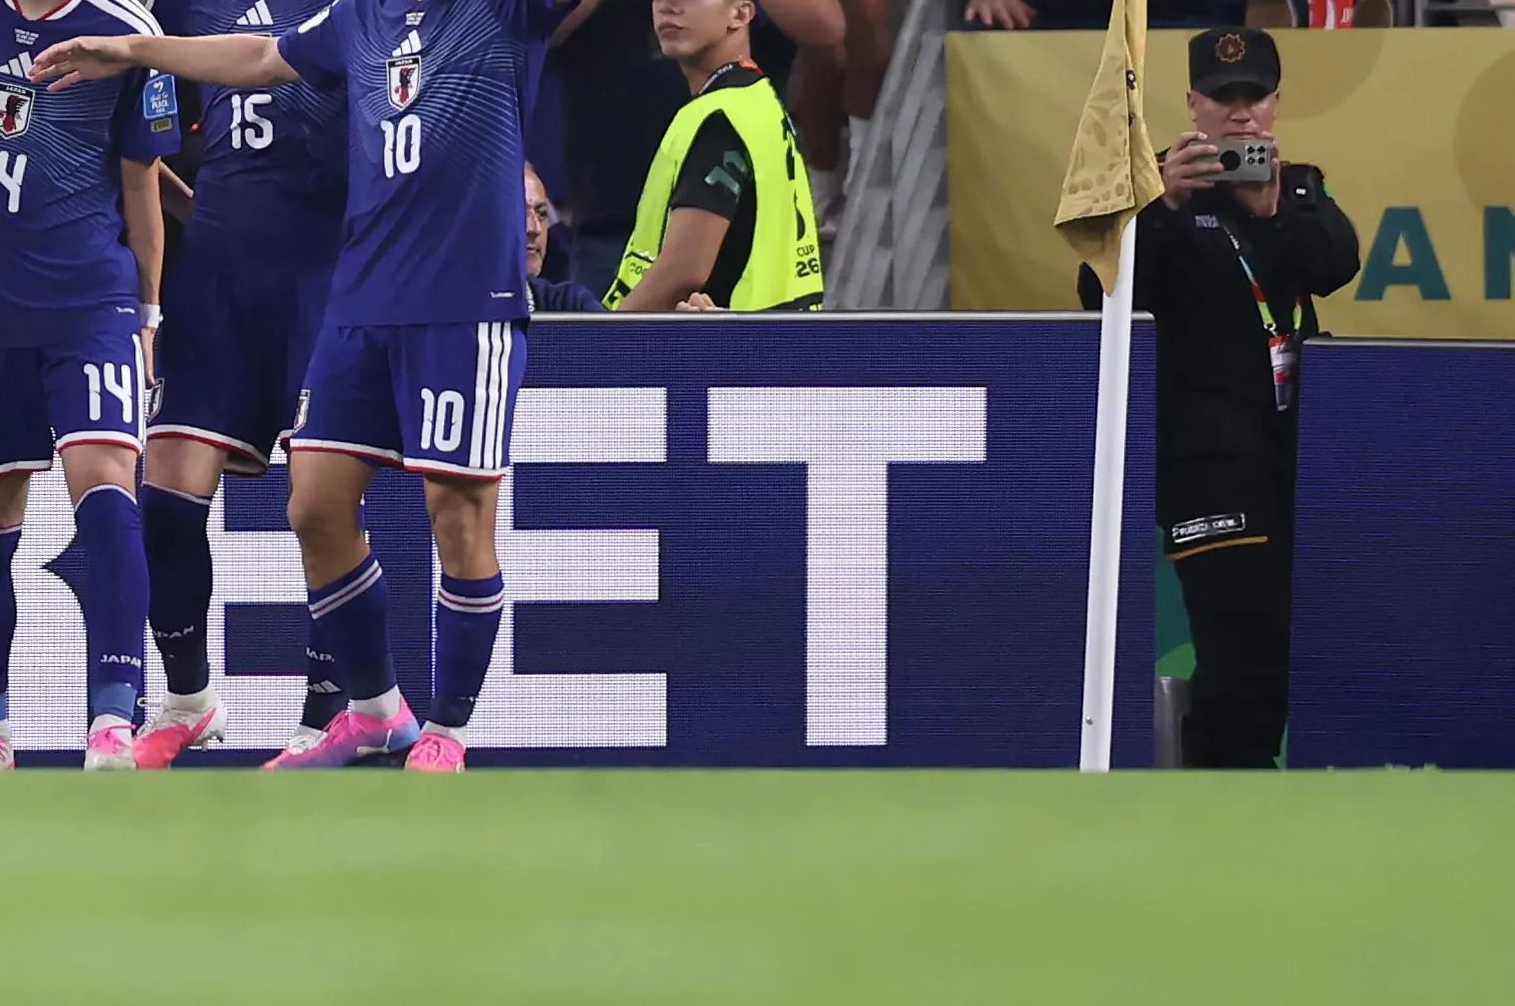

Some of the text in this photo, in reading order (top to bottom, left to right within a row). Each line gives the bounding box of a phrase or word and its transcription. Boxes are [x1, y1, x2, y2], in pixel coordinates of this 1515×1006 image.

[230, 93, 274, 150] 15
[380, 113, 422, 179] 10
[795, 257, 820, 278] 26
[796, 244, 816, 258] CUP
[83, 362, 133, 424] 14
[420, 387, 465, 452] 10
